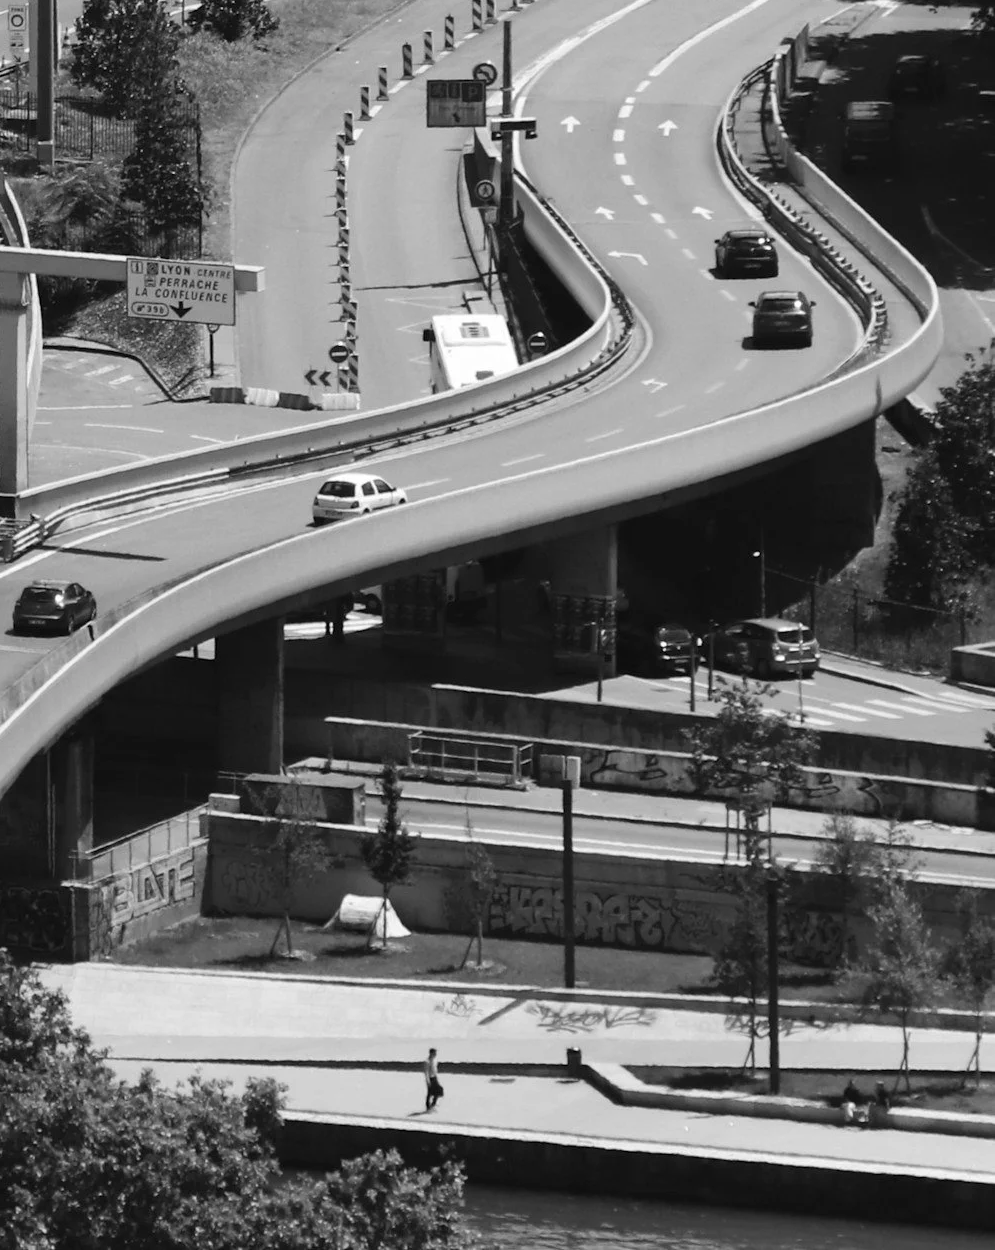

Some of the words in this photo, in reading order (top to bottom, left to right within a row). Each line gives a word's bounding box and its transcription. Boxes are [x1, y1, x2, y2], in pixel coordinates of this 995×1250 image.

[161, 264, 191, 276] LYON
[197, 268, 232, 280] CENTRE
[159, 277, 220, 291] PERRACHE
[135, 287, 148, 297] LA
[155, 288, 229, 304] CONFLUENCE
